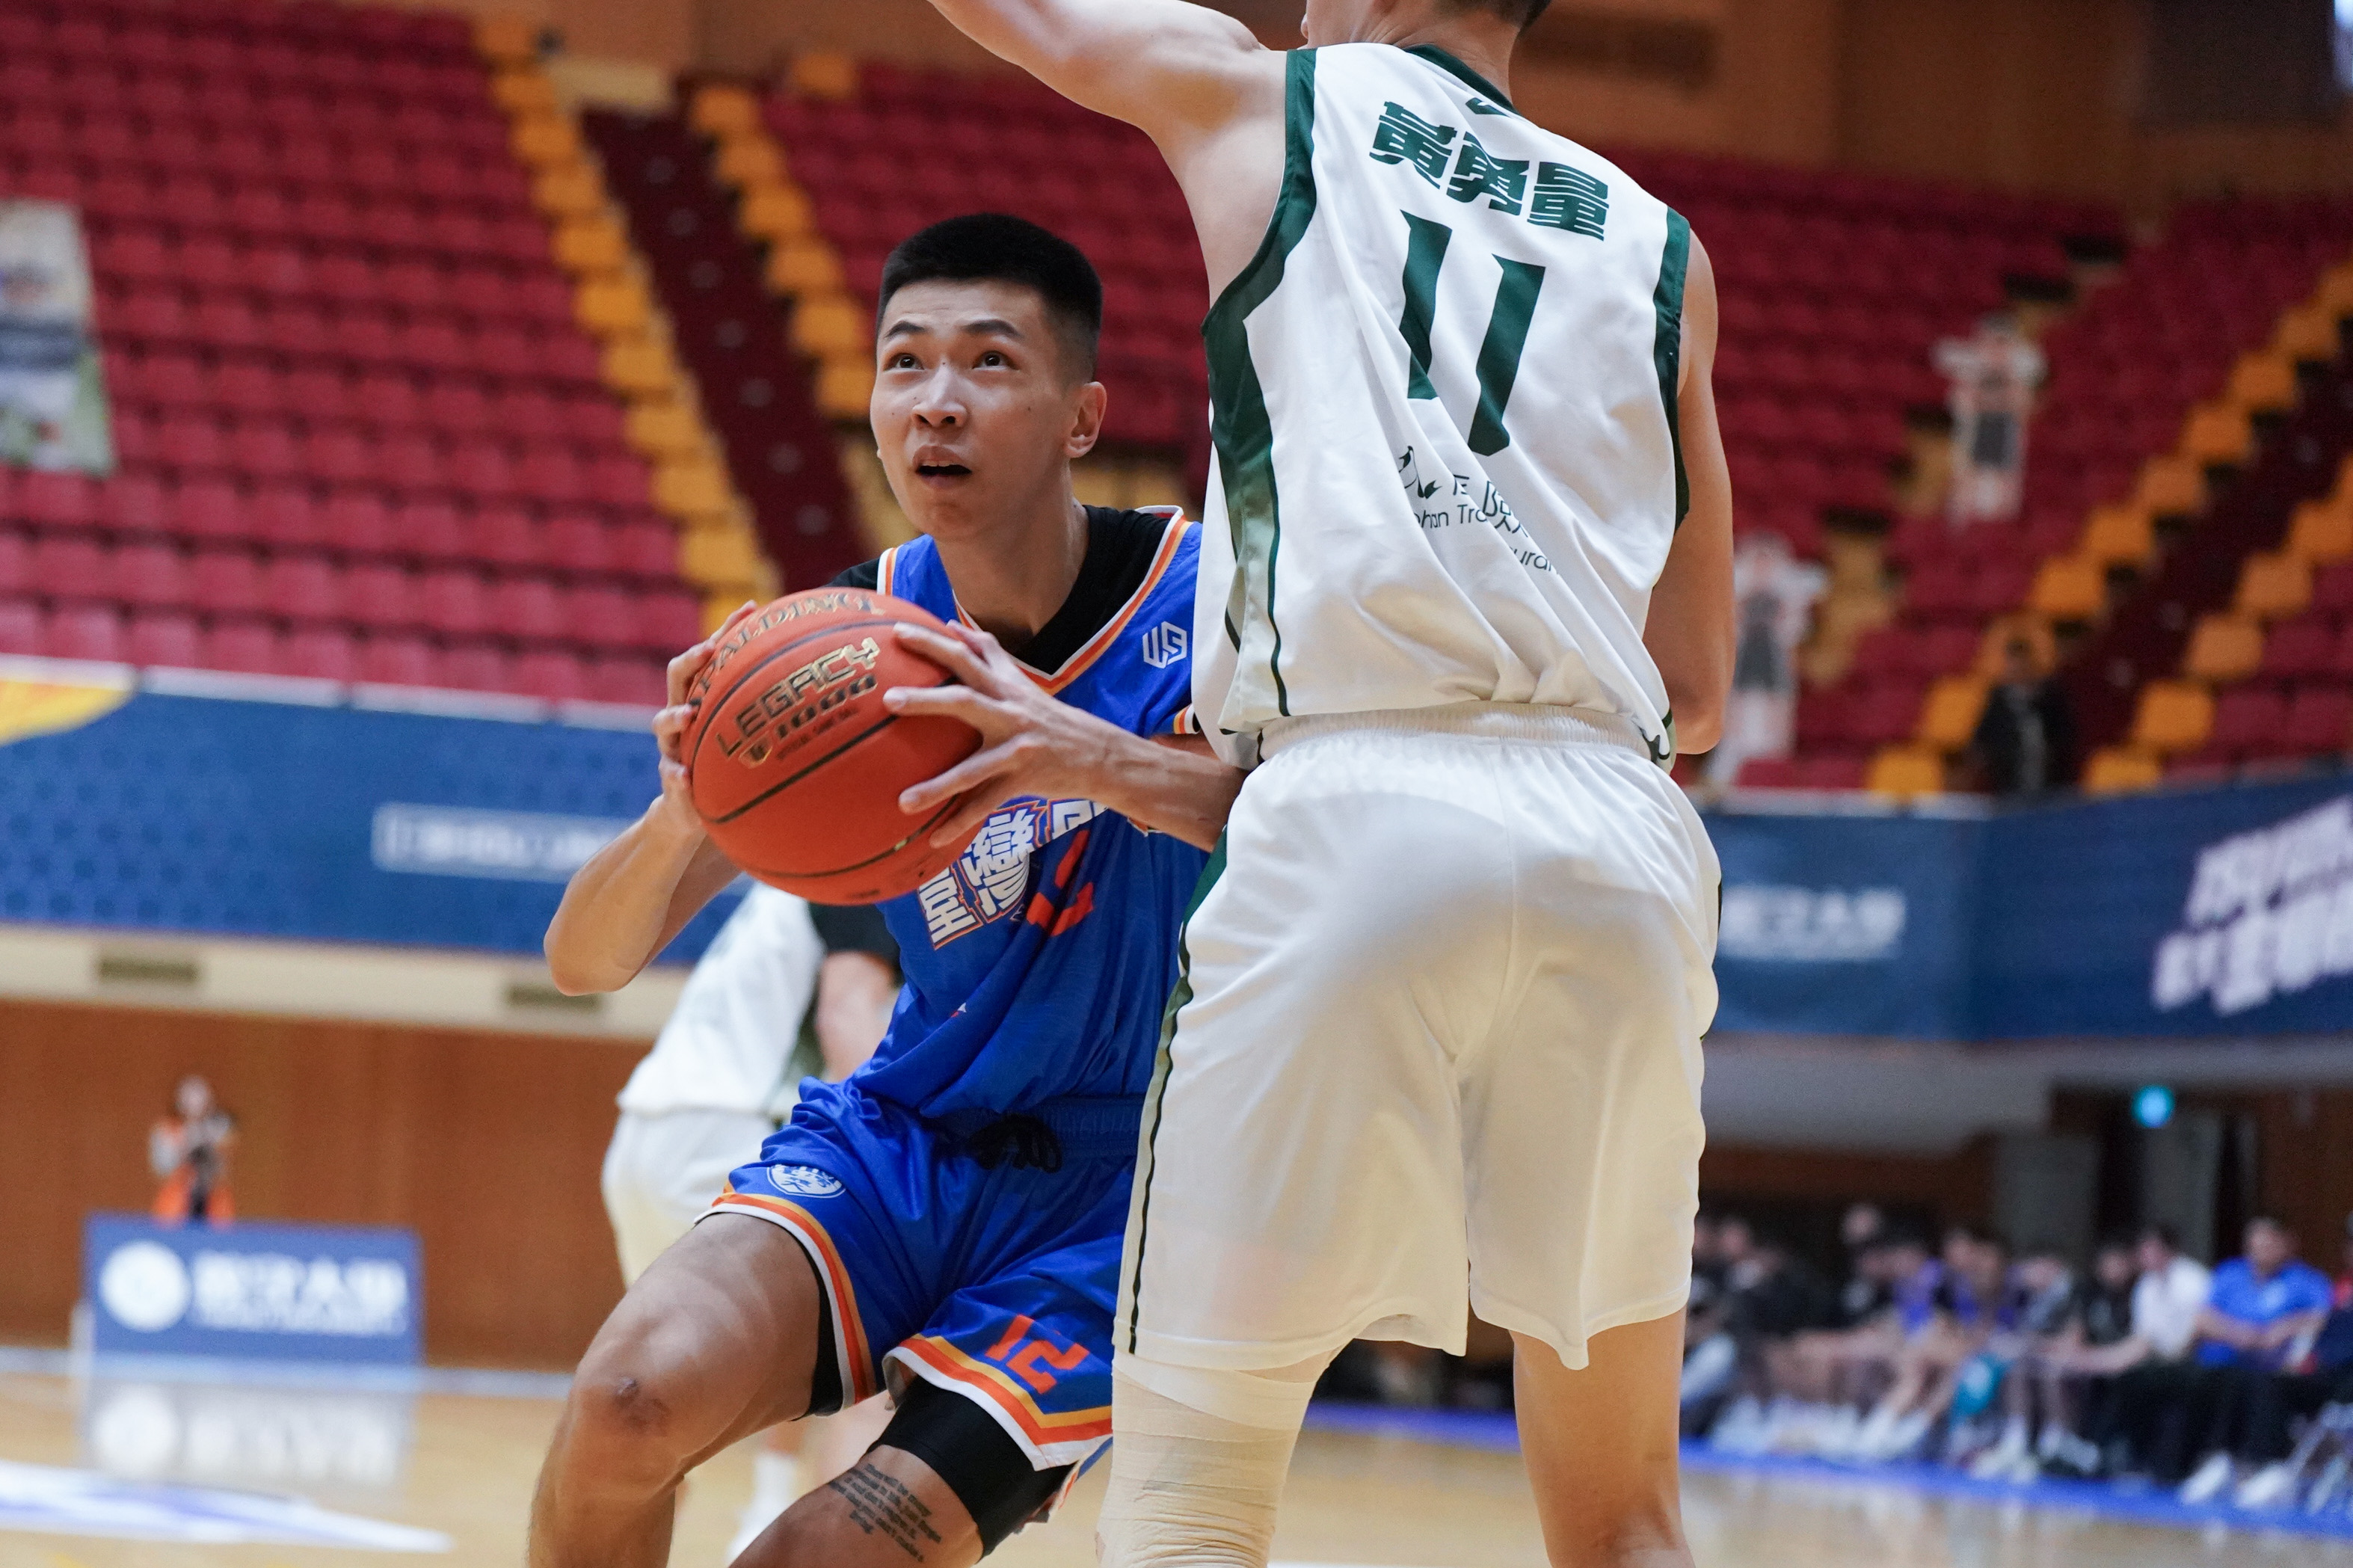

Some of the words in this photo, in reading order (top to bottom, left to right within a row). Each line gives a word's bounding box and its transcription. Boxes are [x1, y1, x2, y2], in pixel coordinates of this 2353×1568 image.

[1399, 209, 1546, 457] 11
[1414, 508, 1449, 529] han
[715, 636, 881, 759] LEGACY
[985, 1314, 1090, 1395] 12
